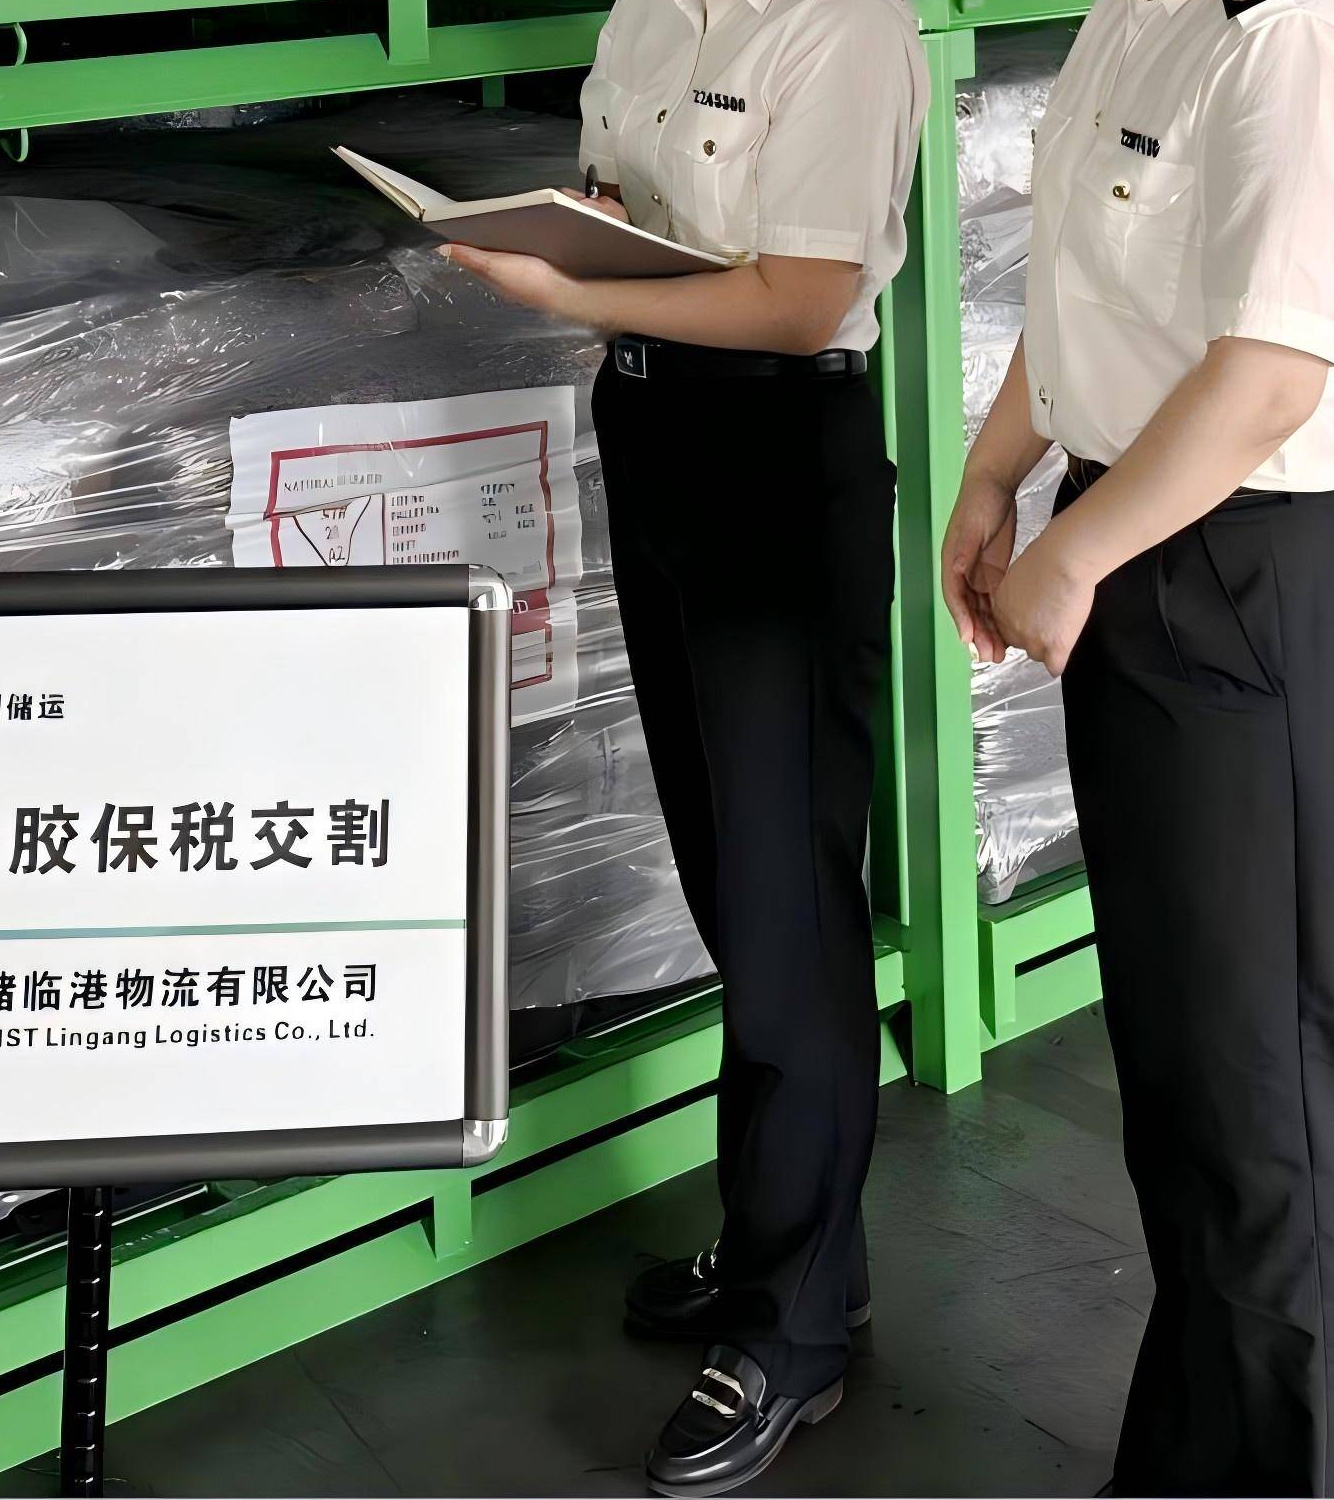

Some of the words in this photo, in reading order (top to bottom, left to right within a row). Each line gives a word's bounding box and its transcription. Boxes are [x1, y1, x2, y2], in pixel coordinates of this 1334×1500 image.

[46, 1027, 147, 1050] Lingang
[155, 1023, 267, 1047] Logistics
[274, 1021, 320, 1041] Co.,
[329, 1018, 375, 1039] Ltd.
